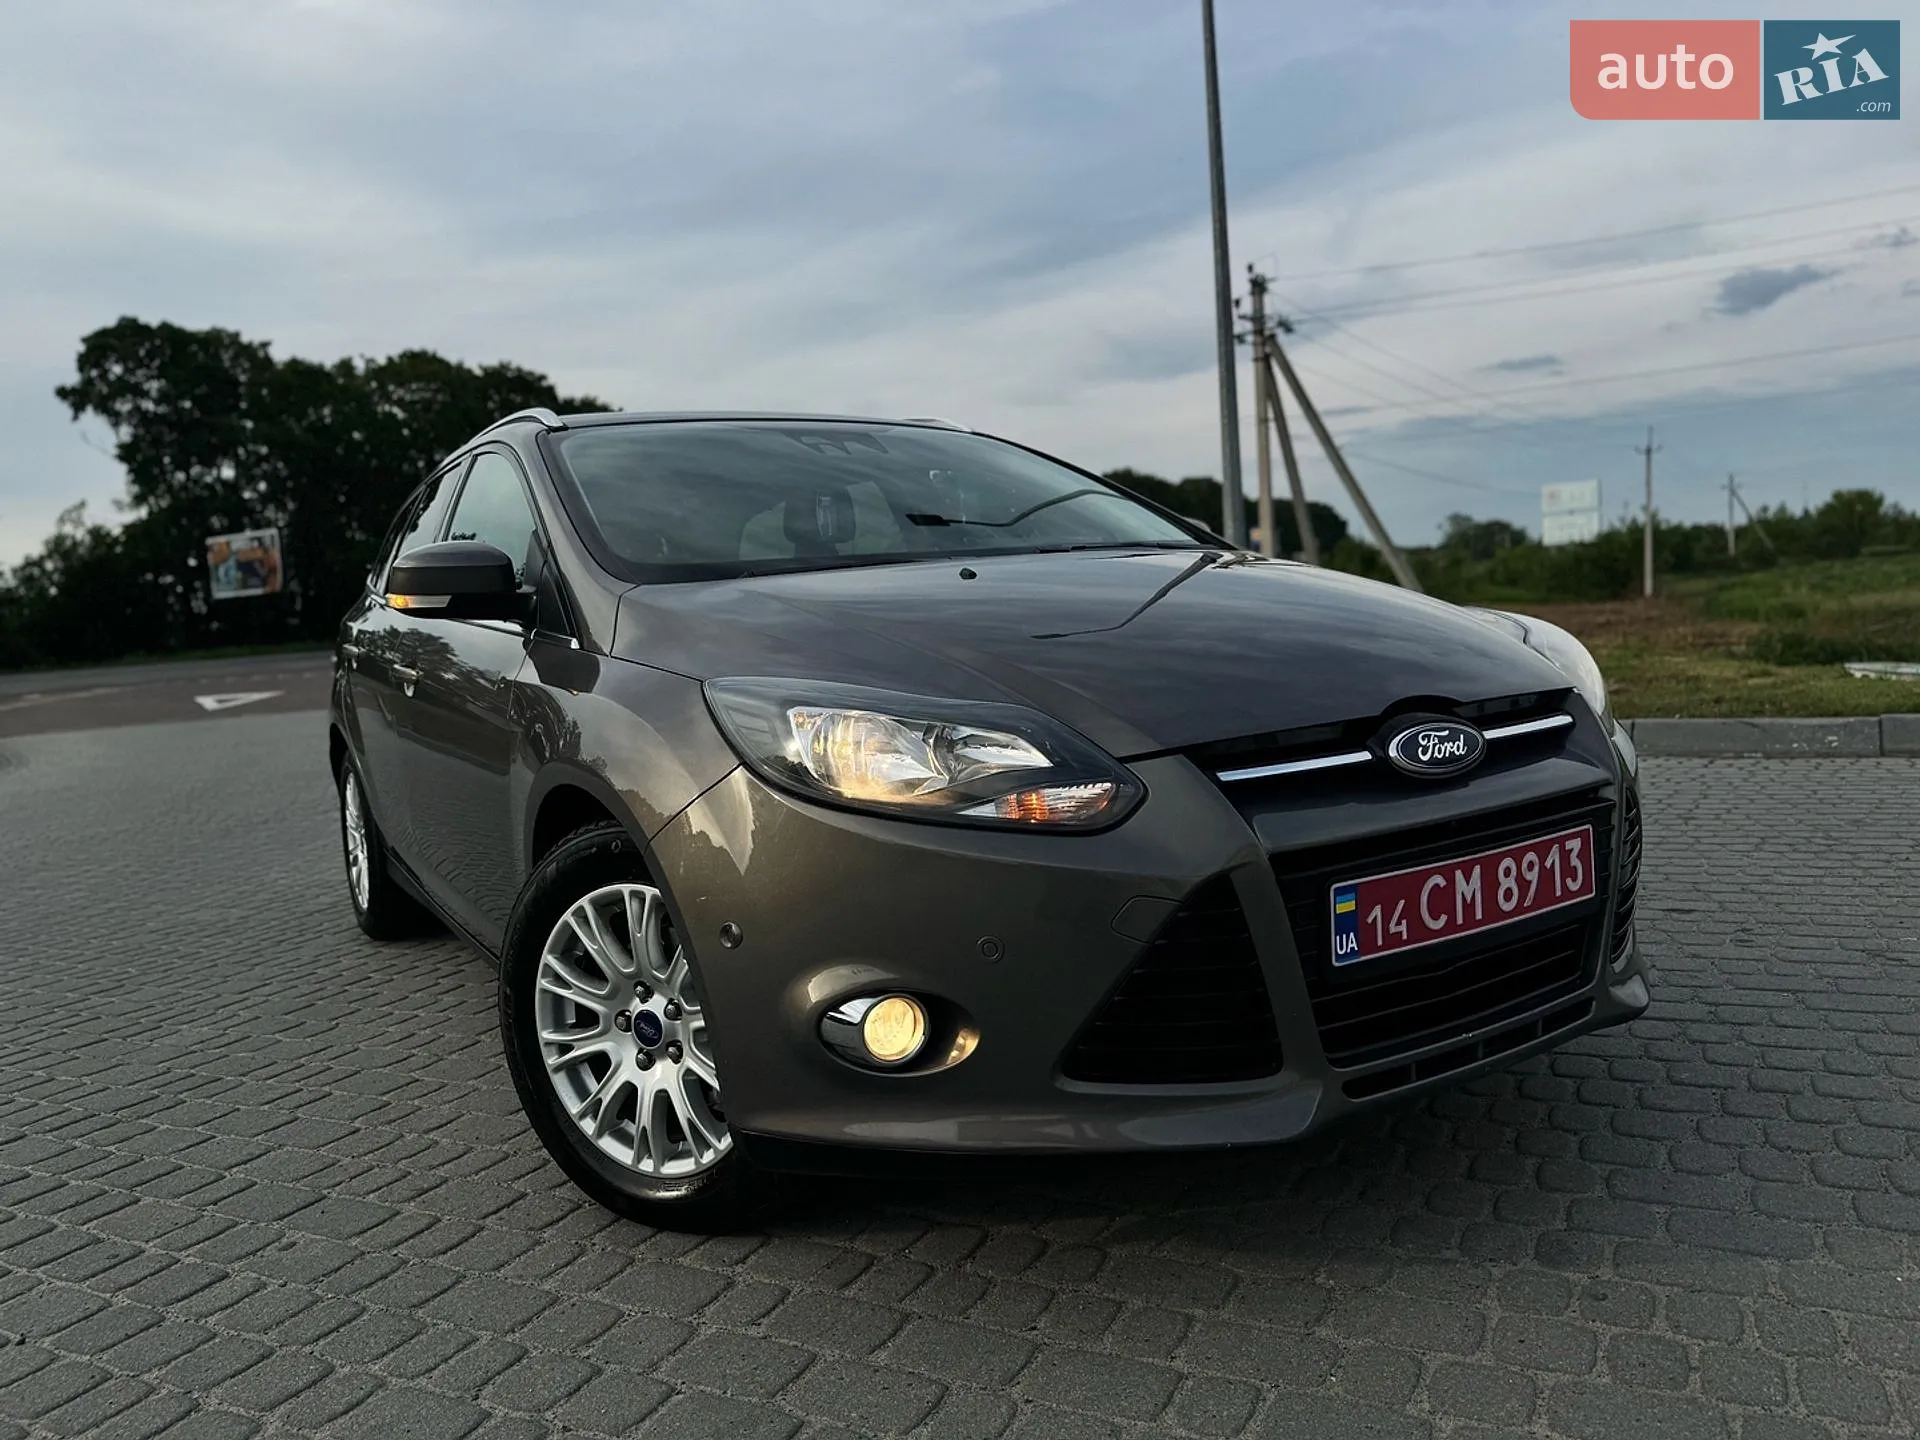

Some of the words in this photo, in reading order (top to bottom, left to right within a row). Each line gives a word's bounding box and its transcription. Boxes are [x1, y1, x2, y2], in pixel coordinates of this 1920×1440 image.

[1418, 730, 1467, 761] Ford
[1366, 899, 1408, 946] 14
[1420, 864, 1483, 930] CM
[1497, 837, 1584, 912] 8913
[1336, 931, 1359, 955] UA
